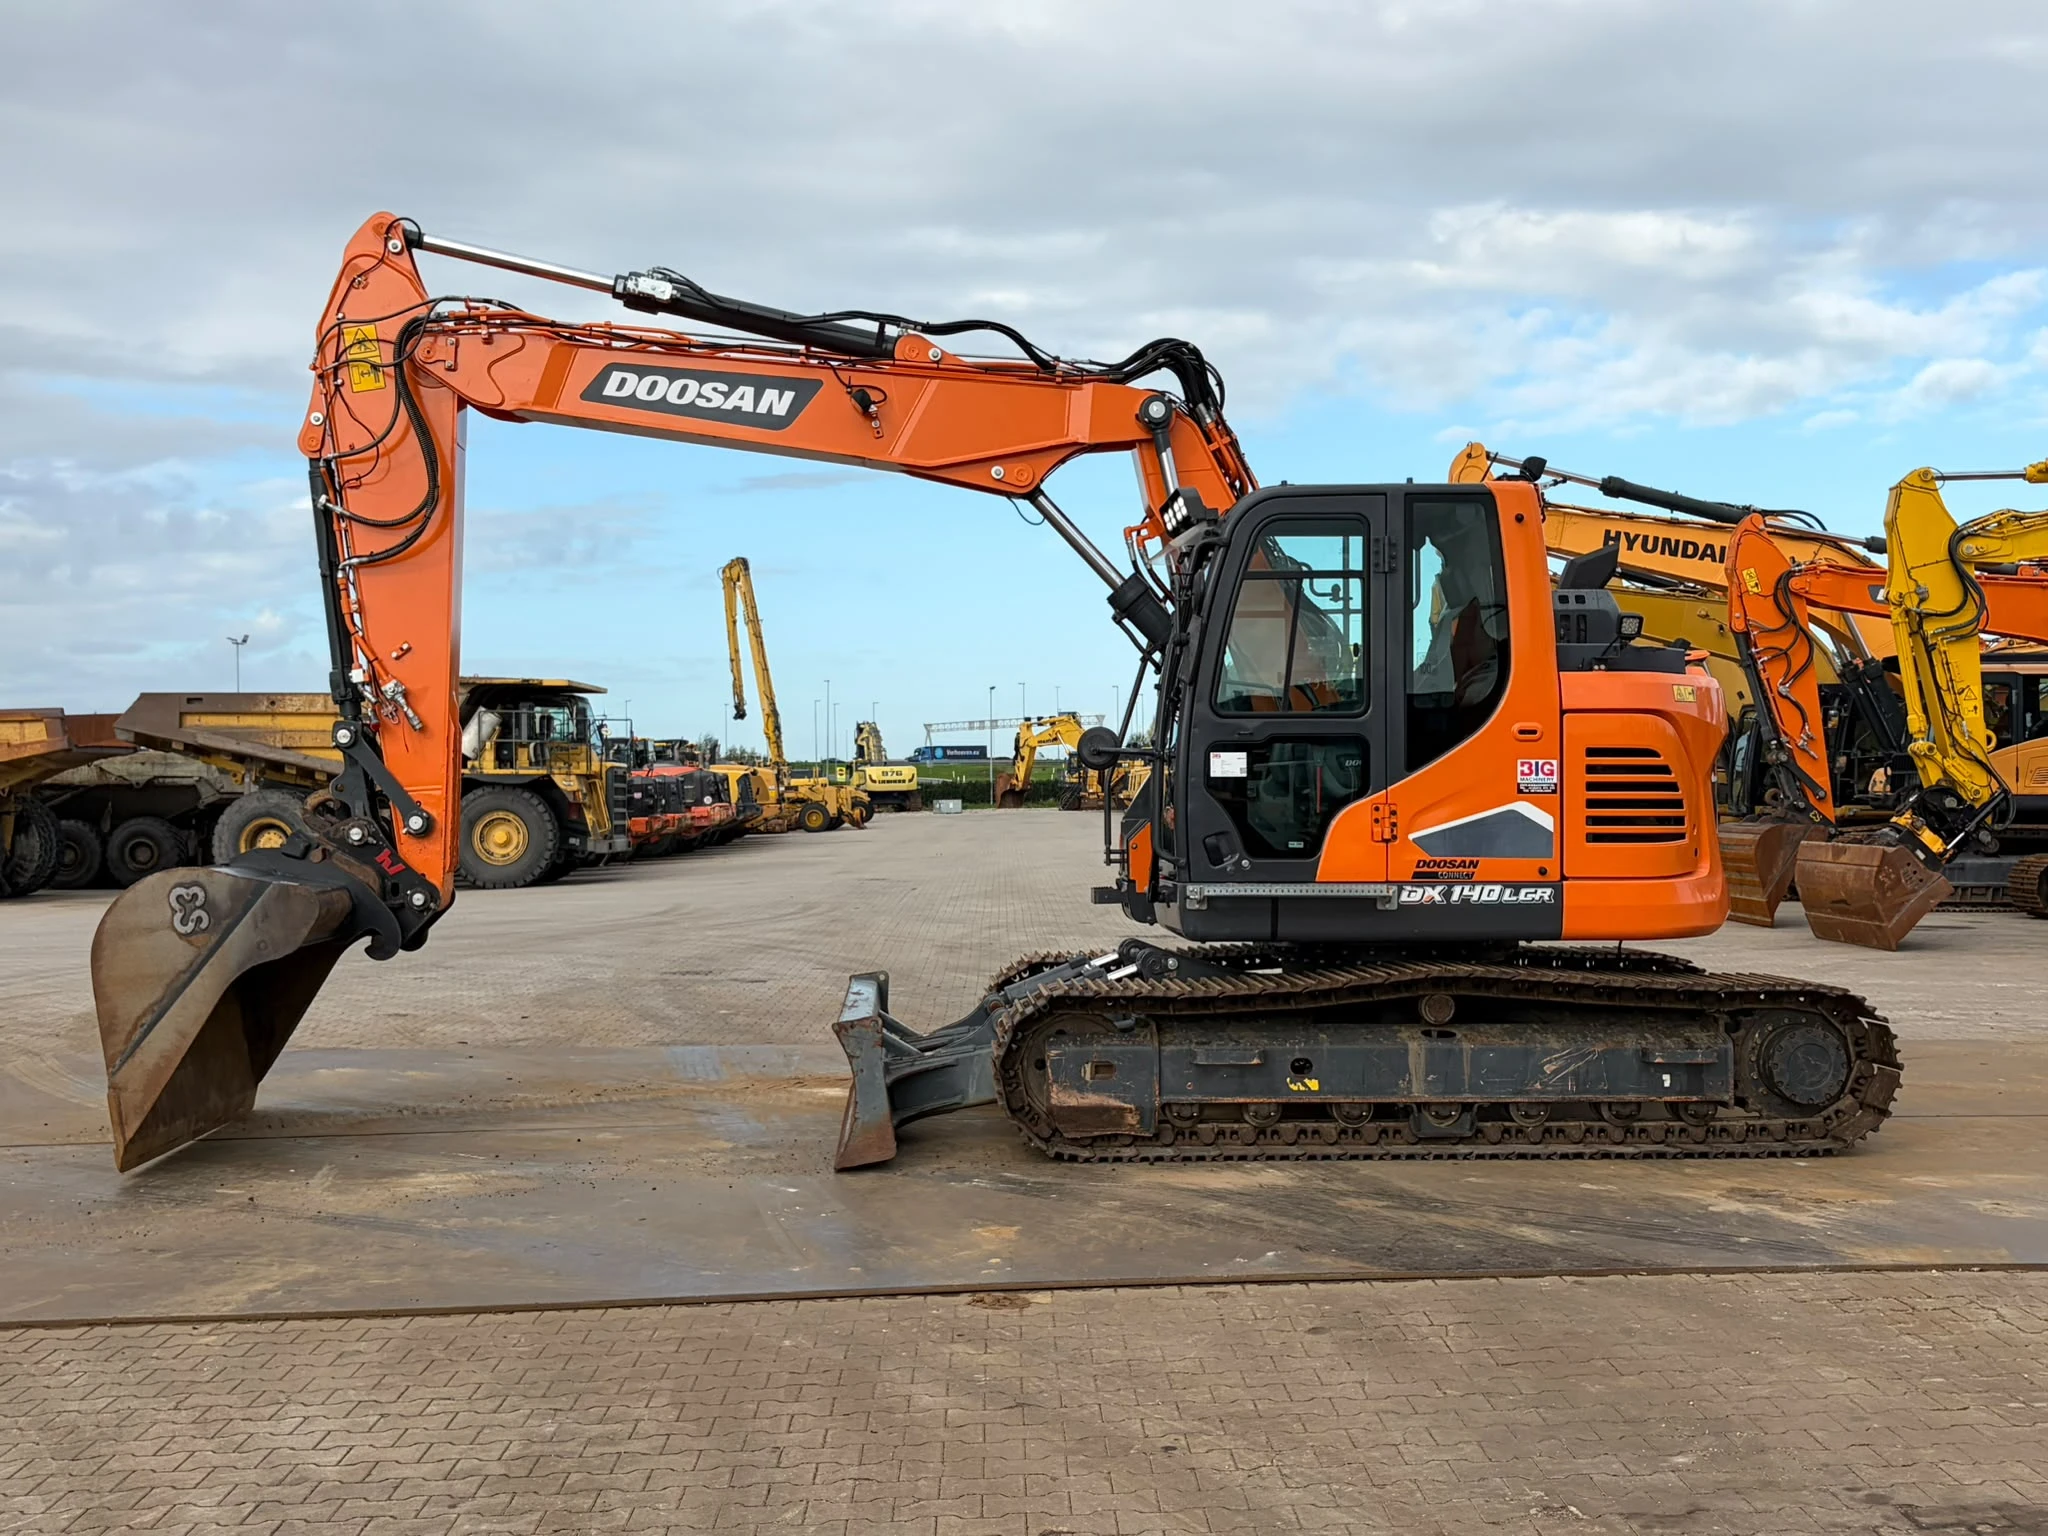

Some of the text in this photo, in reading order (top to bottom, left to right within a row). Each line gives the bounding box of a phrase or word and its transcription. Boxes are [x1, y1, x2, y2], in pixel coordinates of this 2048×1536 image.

[602, 370, 796, 417] DOOSAN
[1603, 529, 1727, 564] HYUNDAI
[1415, 859, 1480, 869] DOOSAN
[1437, 871, 1473, 879] CONNECT
[1400, 885, 1447, 904] DX
